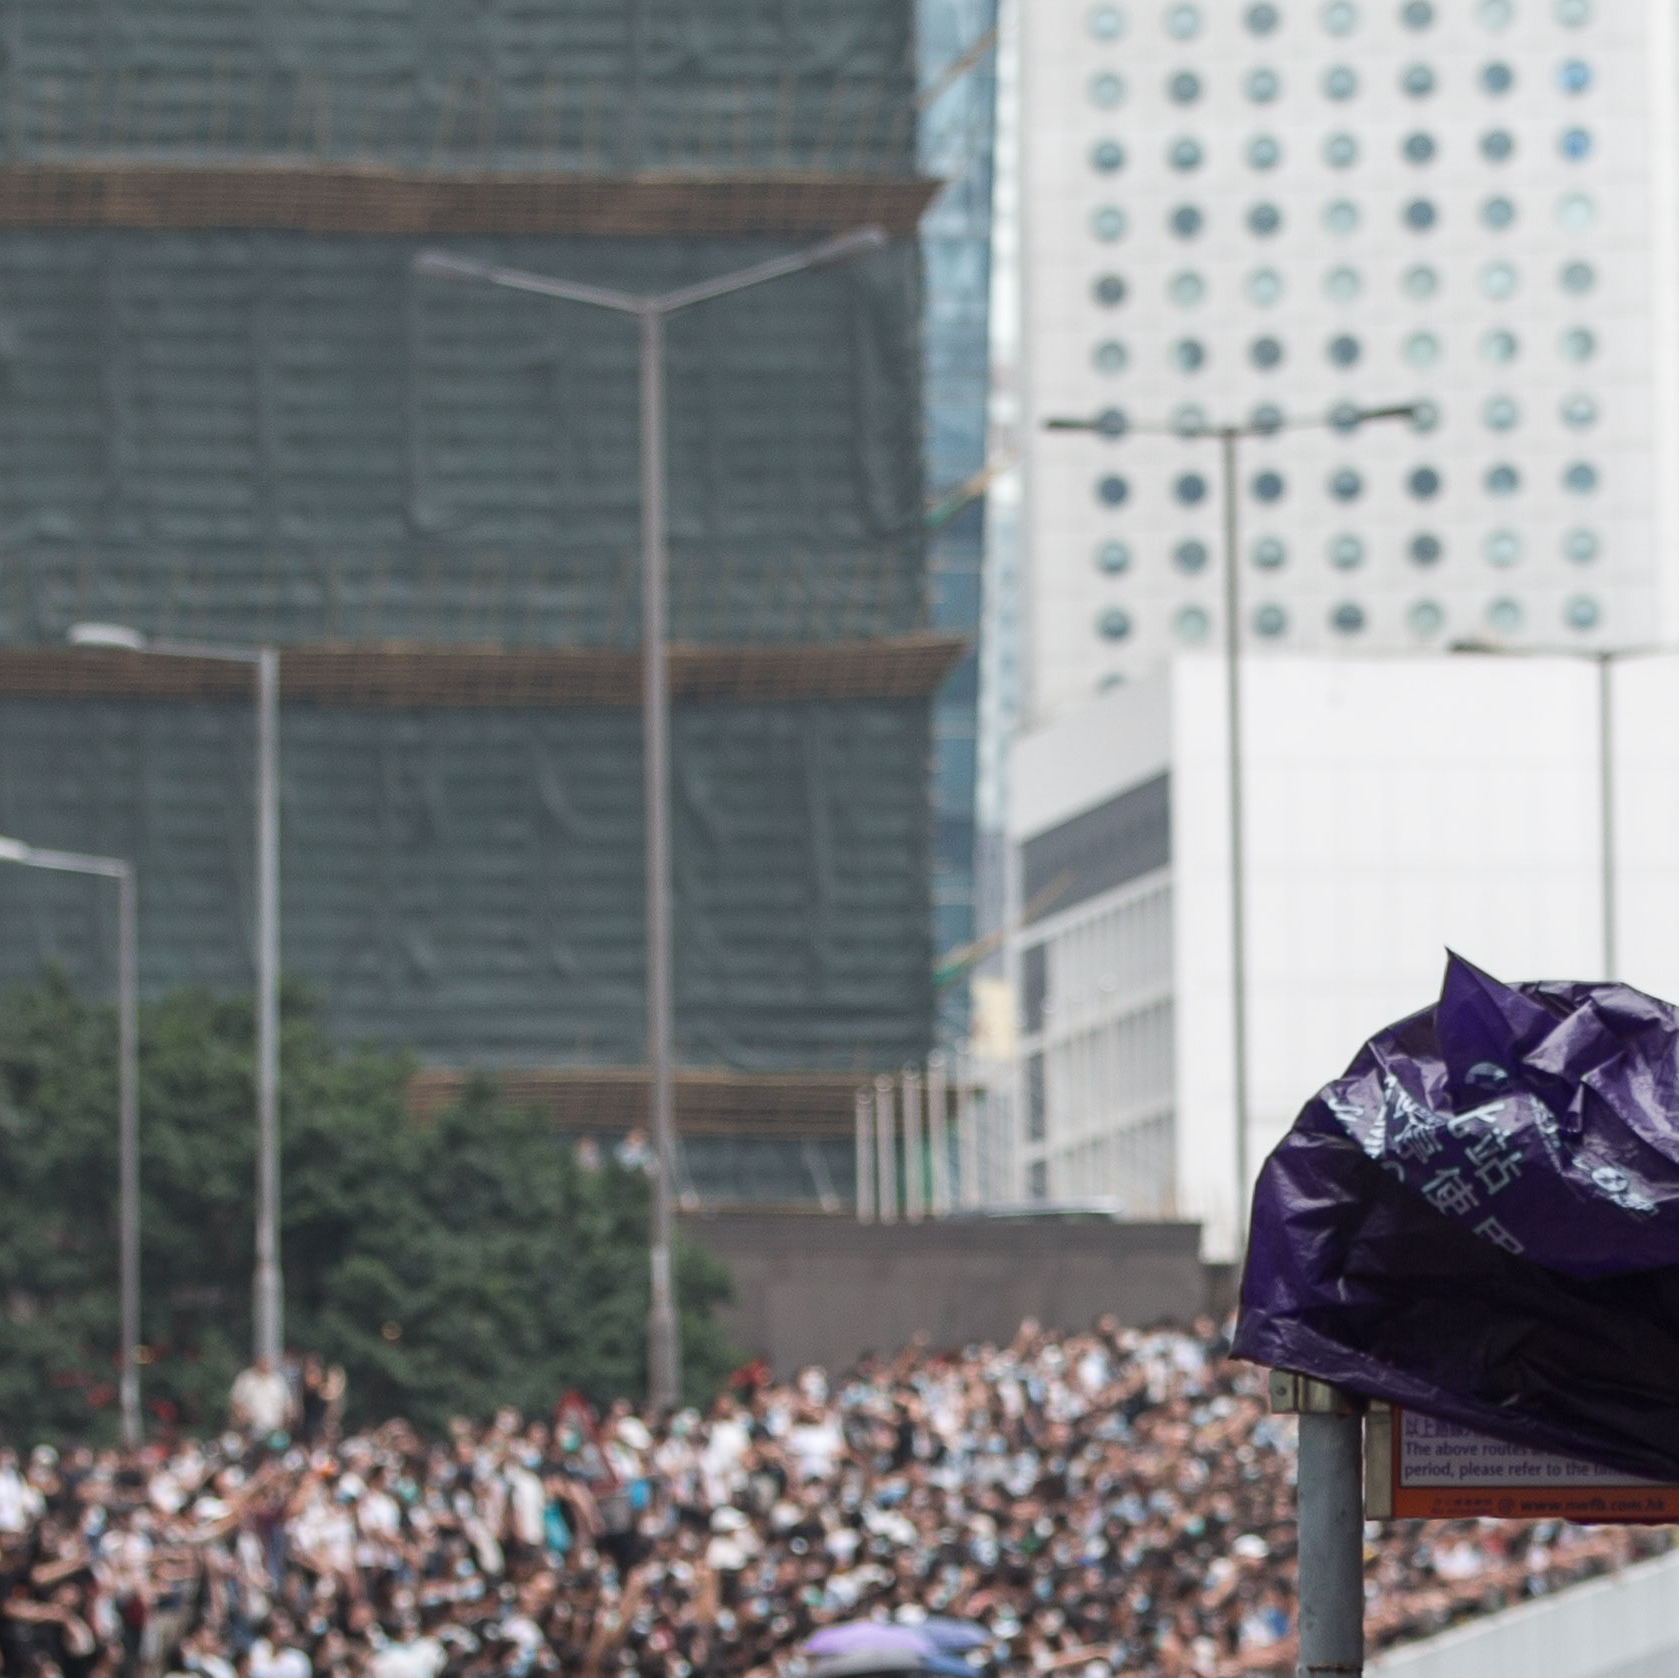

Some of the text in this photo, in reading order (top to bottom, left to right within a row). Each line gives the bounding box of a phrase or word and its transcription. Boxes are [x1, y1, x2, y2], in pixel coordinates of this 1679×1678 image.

[1405, 1442, 1433, 1456] The
[1436, 1442, 1478, 1456] above
[1405, 1462, 1455, 1479] period,
[1459, 1463, 1504, 1479] please
[1508, 1462, 1542, 1476] refer
[1547, 1463, 1562, 1476] to
[1566, 1462, 1588, 1476] the
